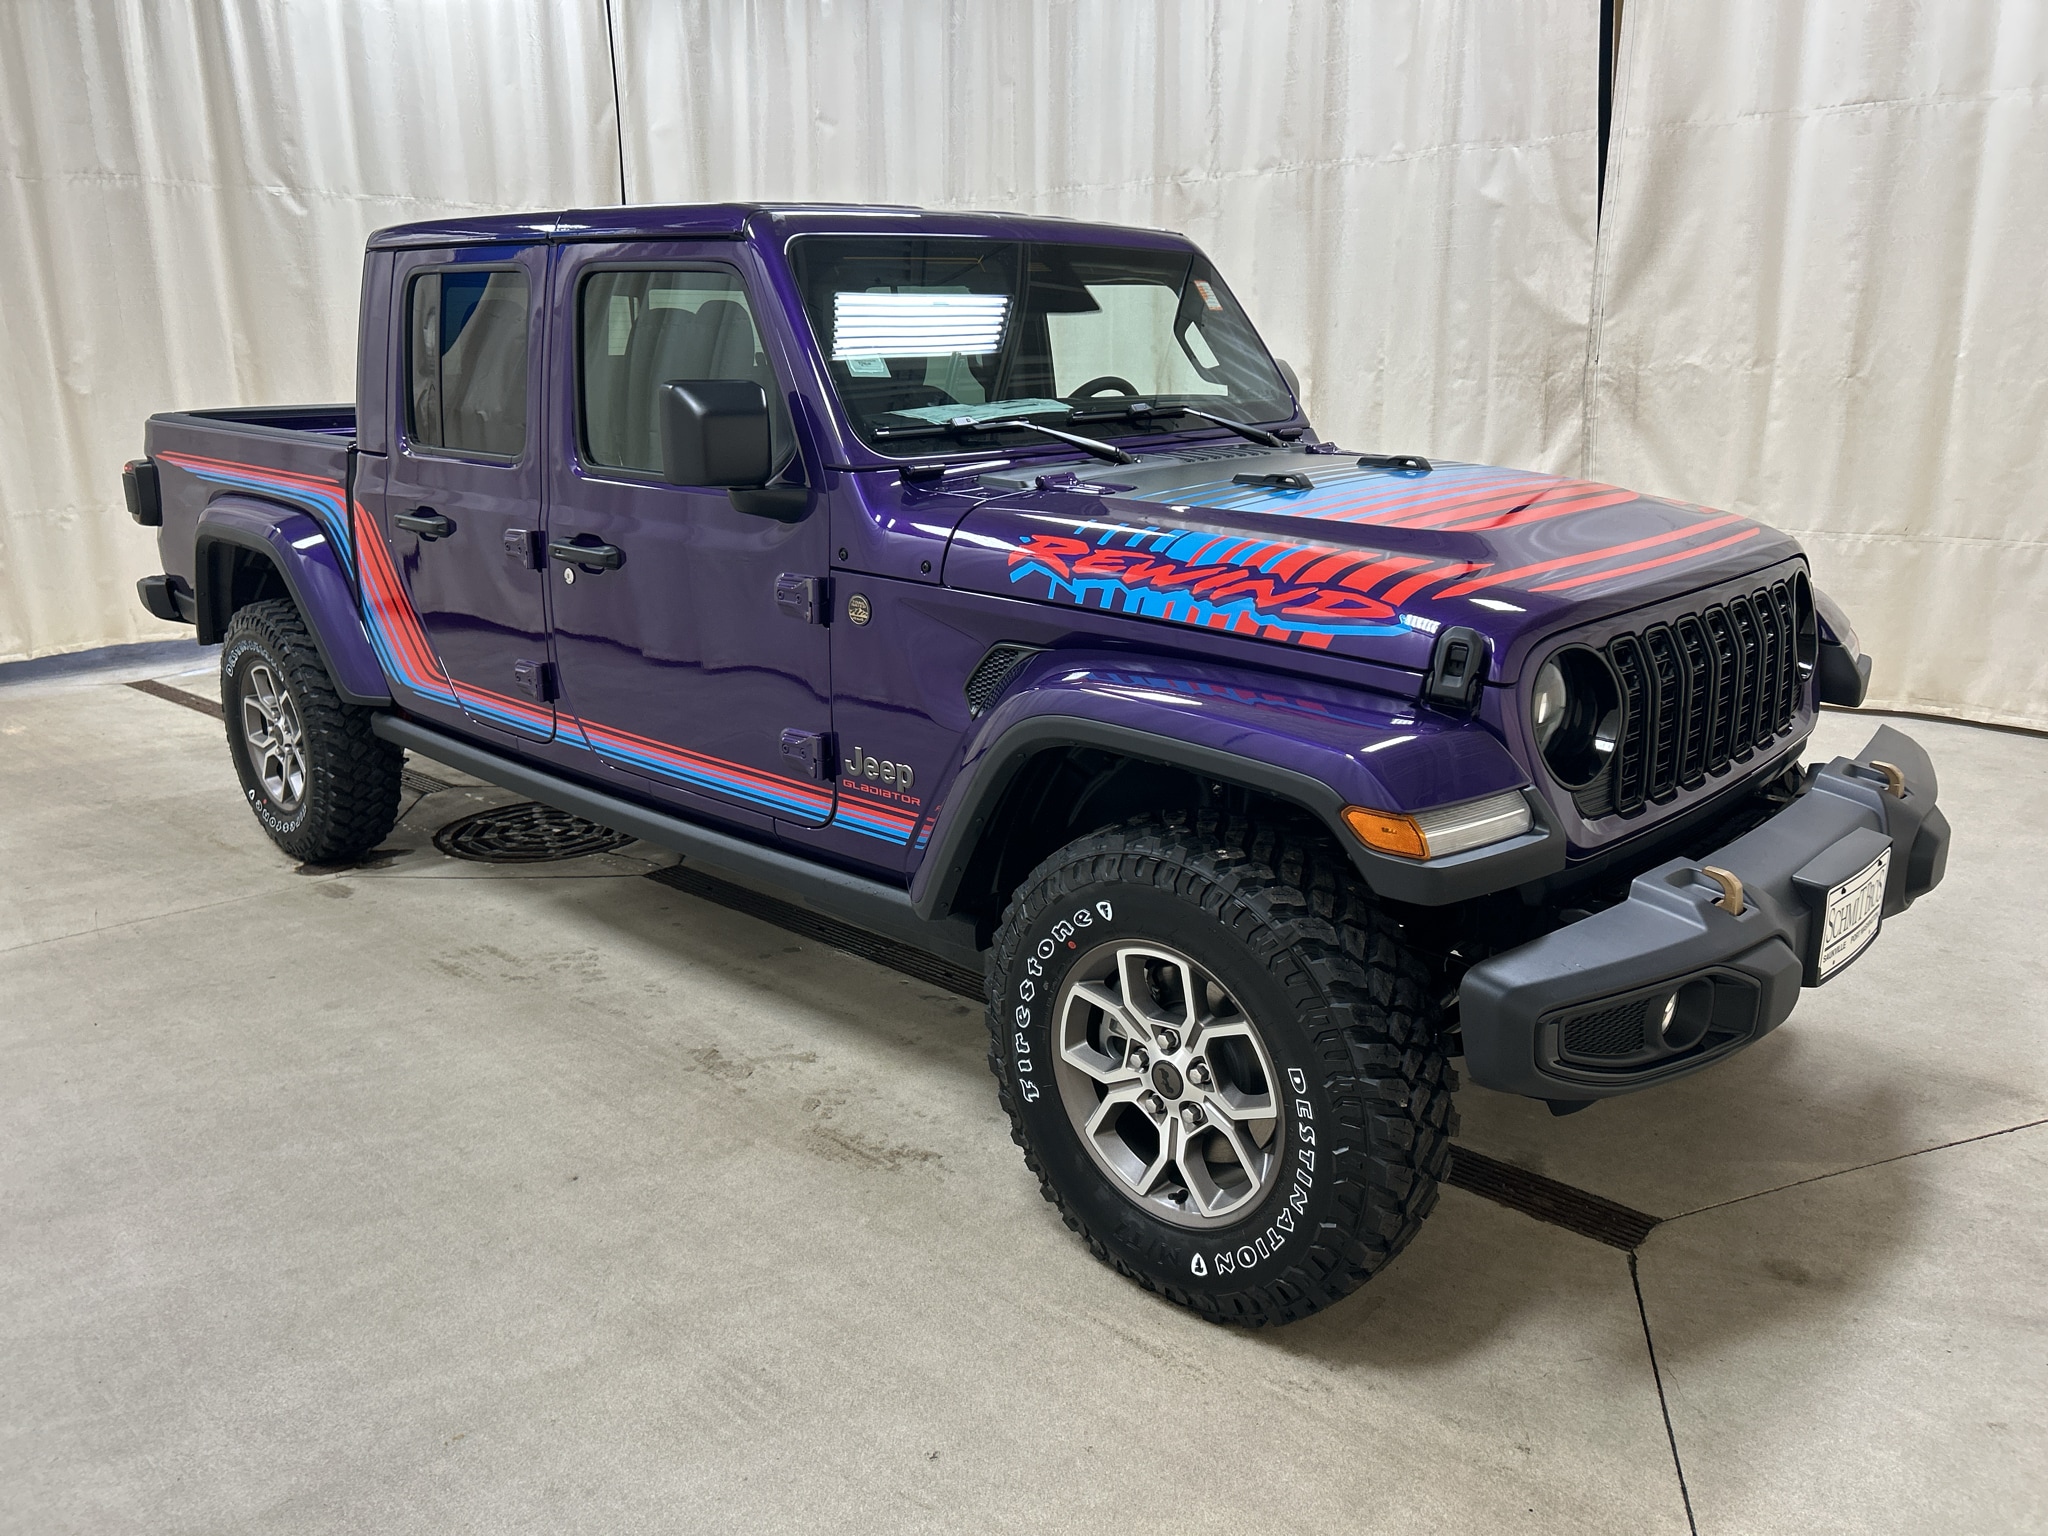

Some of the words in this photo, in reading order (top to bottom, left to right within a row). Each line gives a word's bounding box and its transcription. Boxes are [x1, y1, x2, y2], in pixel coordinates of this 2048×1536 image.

[1008, 534, 1396, 619] REWIND
[843, 779, 921, 806] GLADIATOR
[845, 746, 914, 793] Jeep
[1014, 909, 1093, 1103] Firestone
[1214, 1067, 1316, 1276] DESTINATION
